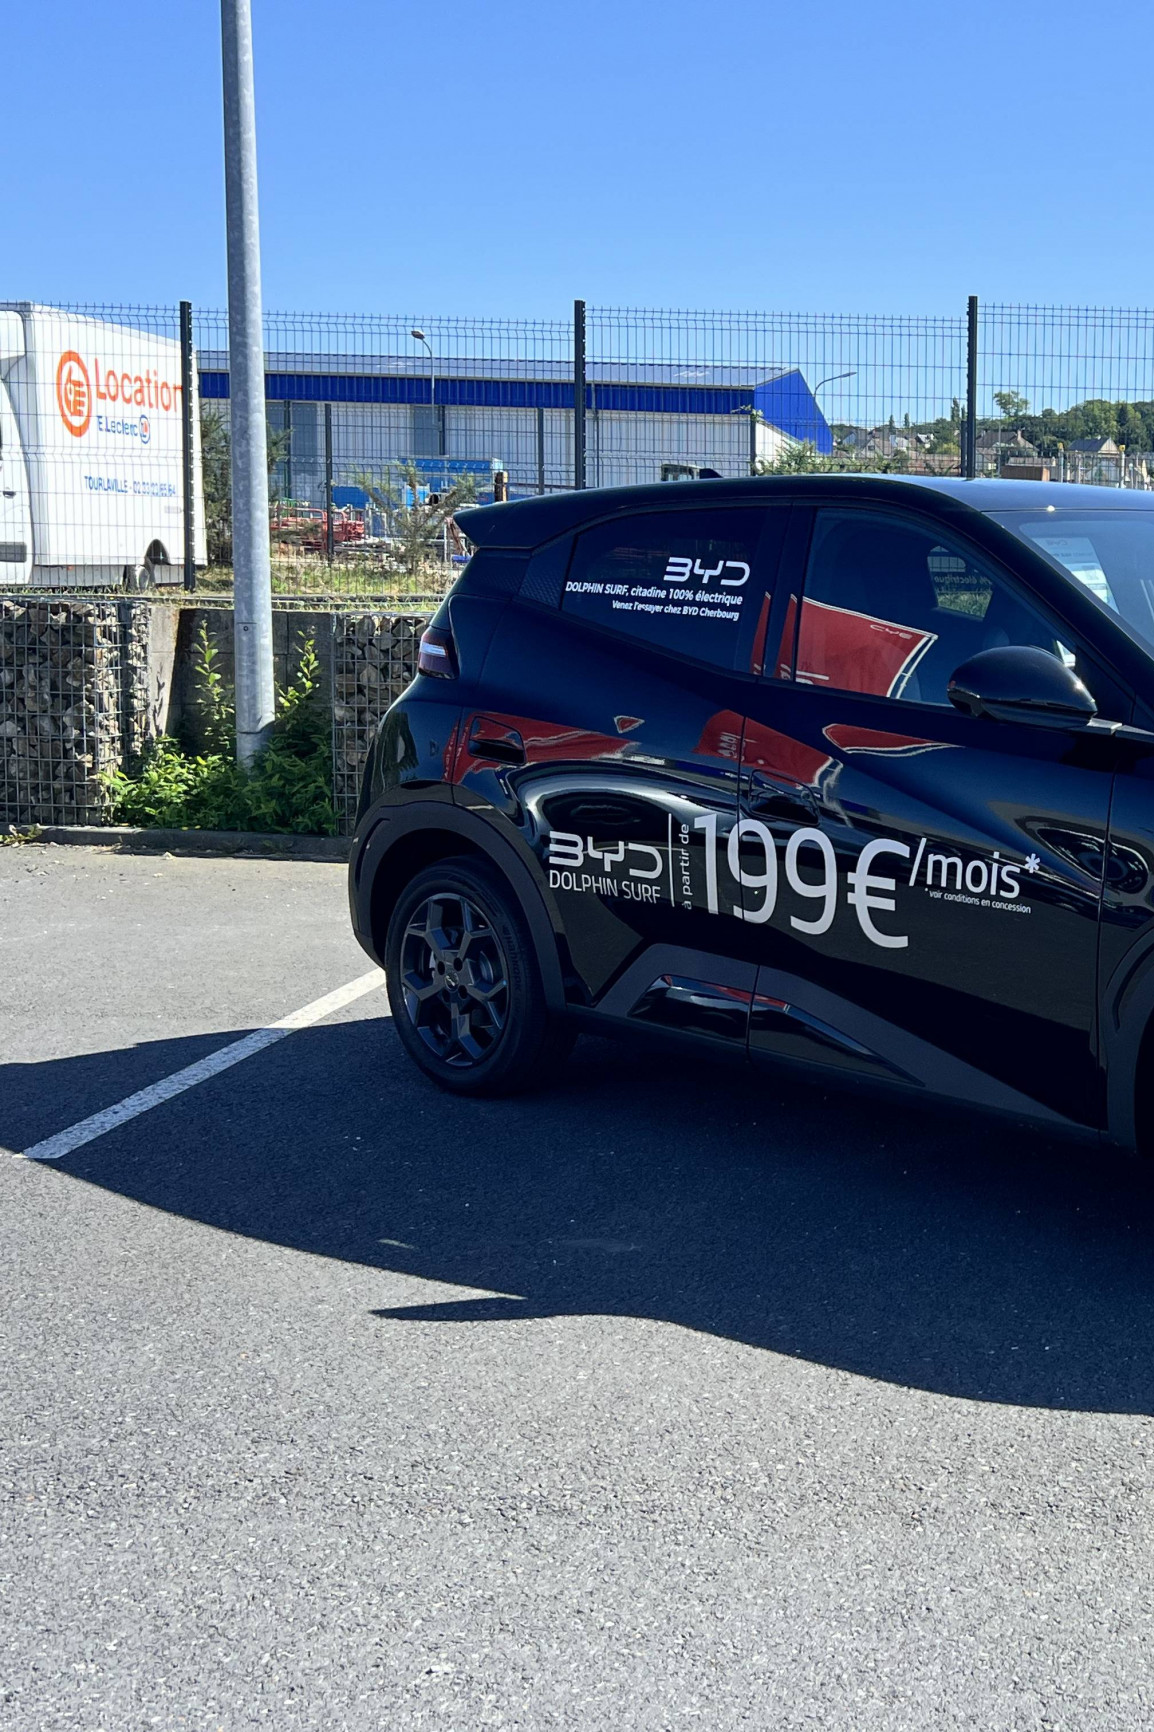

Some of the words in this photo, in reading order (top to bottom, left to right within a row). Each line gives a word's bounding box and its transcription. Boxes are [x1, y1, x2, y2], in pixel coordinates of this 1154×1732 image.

[94, 357, 182, 413] Location
[663, 557, 751, 586] BYD
[565, 581, 604, 593] DOLPHIN
[604, 584, 629, 597] SURF,
[630, 585, 666, 599] citadine
[668, 588, 694, 601] 100%
[695, 589, 743, 606] électrique
[612, 600, 633, 611] Venez
[664, 605, 681, 615] chez
[682, 606, 699, 616] BYD
[699, 608, 740, 621] Cherbourg
[678, 823, 690, 844] de
[548, 830, 663, 879] BYD
[678, 848, 693, 896] partir
[549, 870, 618, 897] DOLPHIN
[622, 881, 661, 904] SURF
[944, 890, 980, 906] conditions
[981, 898, 991, 908] en
[992, 900, 1032, 914] concession
